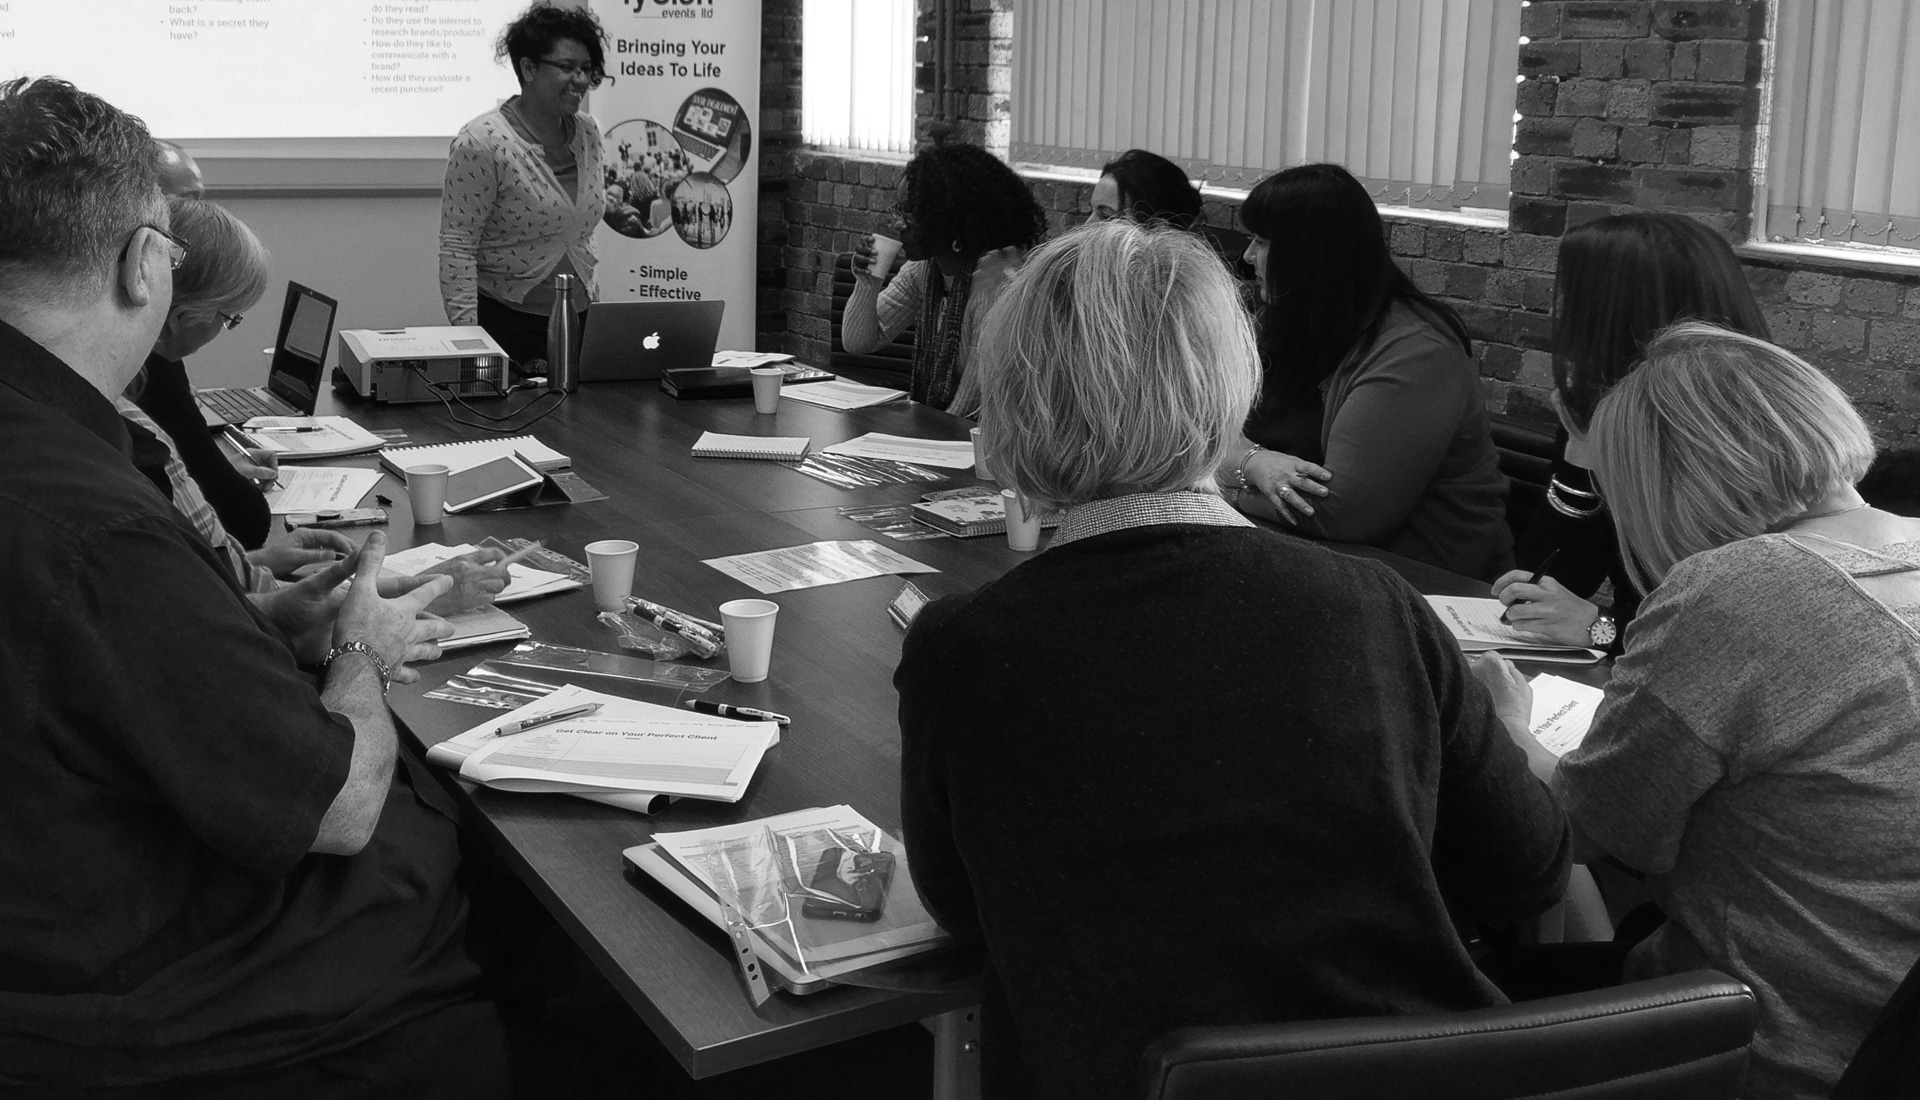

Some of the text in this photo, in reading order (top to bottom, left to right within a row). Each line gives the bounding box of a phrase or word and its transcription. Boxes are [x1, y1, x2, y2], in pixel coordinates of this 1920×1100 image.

[169, 4, 197, 14] back?
[371, 5, 430, 15] do they read?
[661, 7, 714, 19] events ltd
[169, 18, 195, 27] What
[197, 18, 205, 27] is
[216, 19, 247, 28] secret
[248, 19, 270, 30] they
[371, 16, 384, 25] Do
[385, 16, 405, 27] they
[423, 17, 437, 26] the
[439, 17, 471, 26] internet
[473, 17, 482, 26] to
[169, 31, 198, 40] have?
[371, 28, 486, 38] research brands/products?
[371, 39, 452, 50] How do they like to
[617, 38, 726, 58] Bringing Your
[371, 51, 430, 60] communicate
[431, 51, 449, 60] with
[371, 62, 401, 71] brand?
[620, 61, 721, 78] Ideas To Life
[371, 73, 391, 82] How
[392, 73, 407, 82] did
[408, 74, 426, 84] they
[428, 74, 464, 82] evaluate
[371, 85, 443, 95] recent purchase?
[639, 264, 688, 282] Simple
[639, 284, 702, 301] Effective
[1546, 709, 1568, 723] Perfect
[1561, 700, 1580, 711] Client
